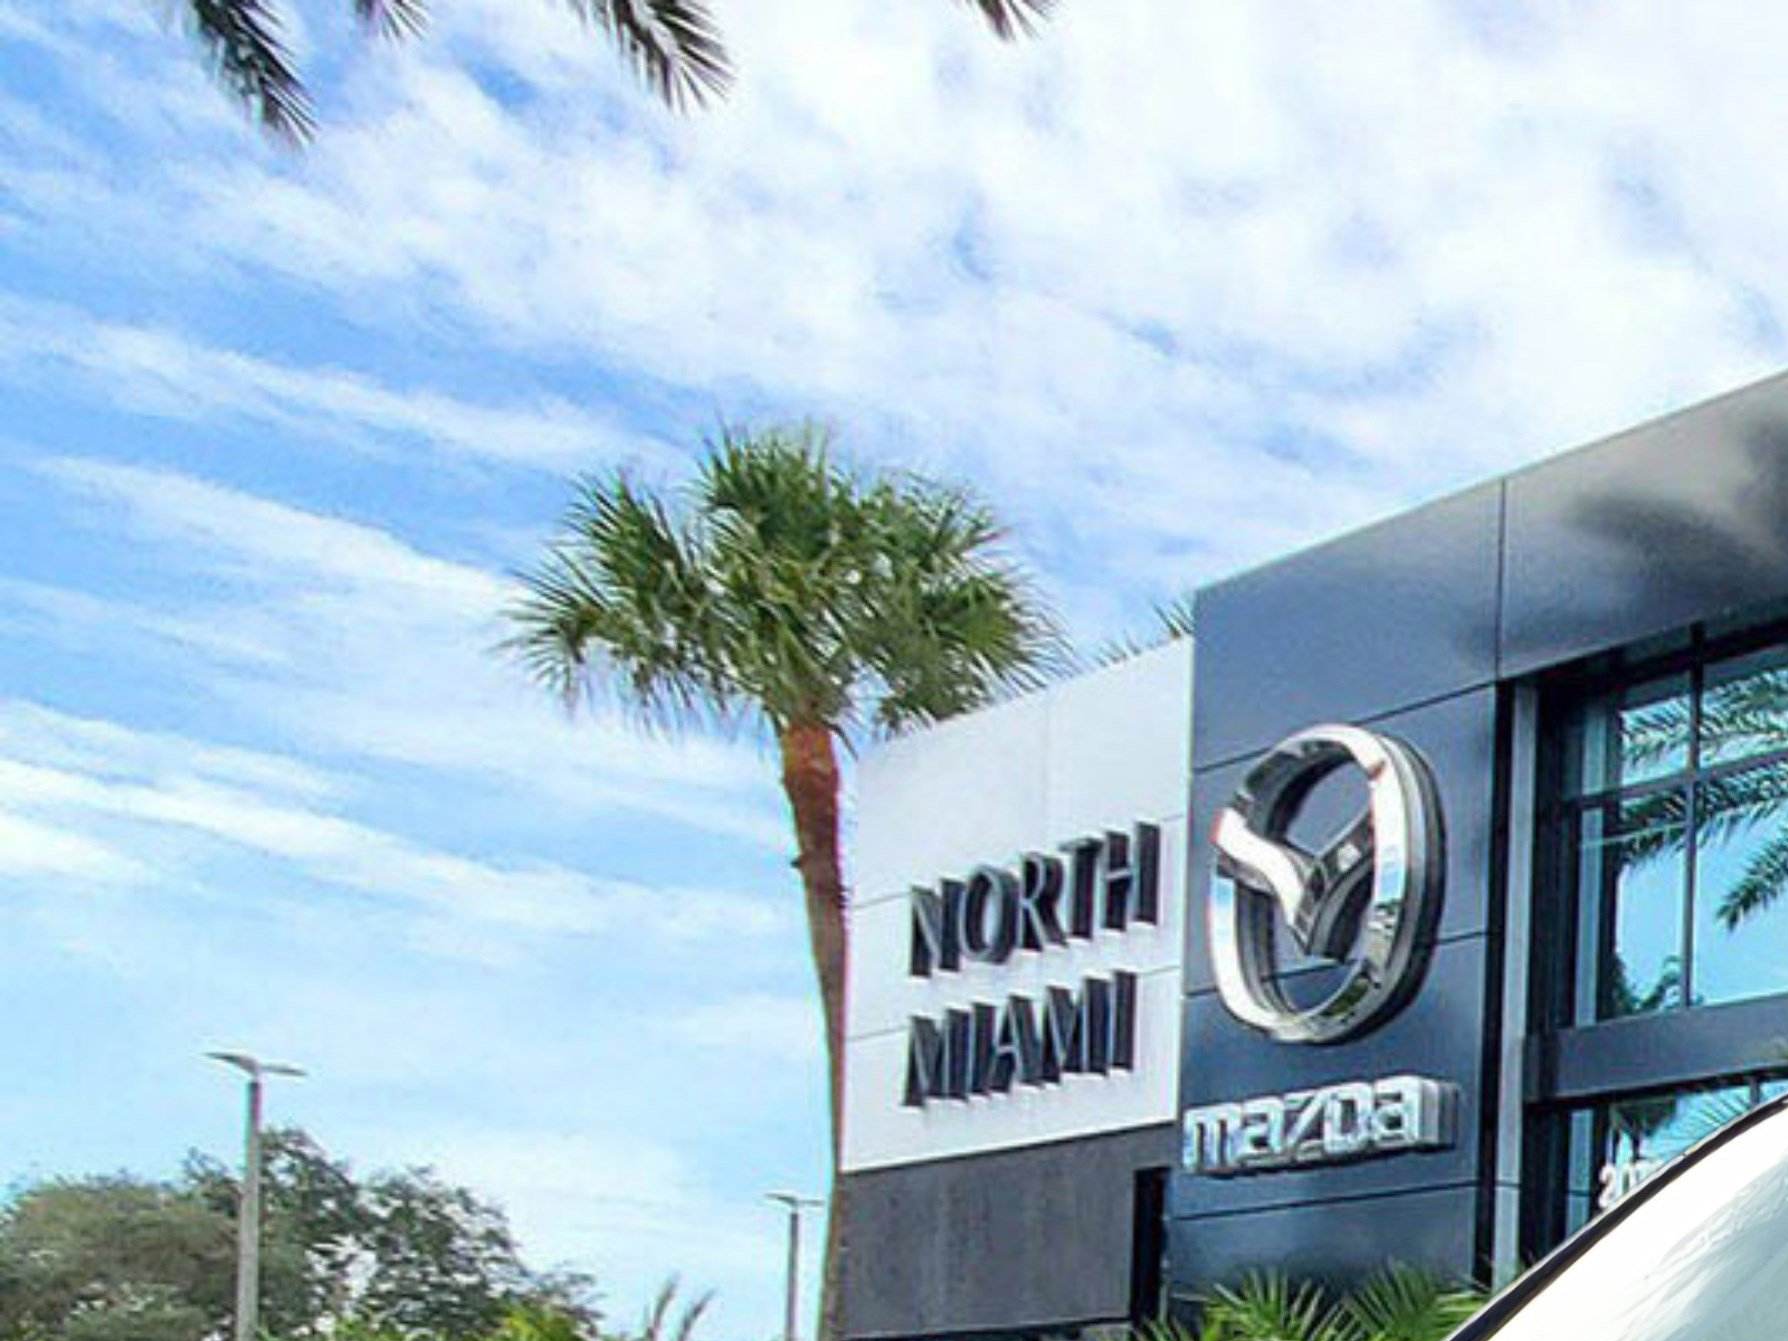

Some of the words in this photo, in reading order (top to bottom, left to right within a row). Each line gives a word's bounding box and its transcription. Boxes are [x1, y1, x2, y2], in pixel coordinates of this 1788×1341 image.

[910, 821, 1161, 979] NORTH
[904, 969, 1137, 1108] MIAMI
[1183, 1076, 1456, 1174] mazda
